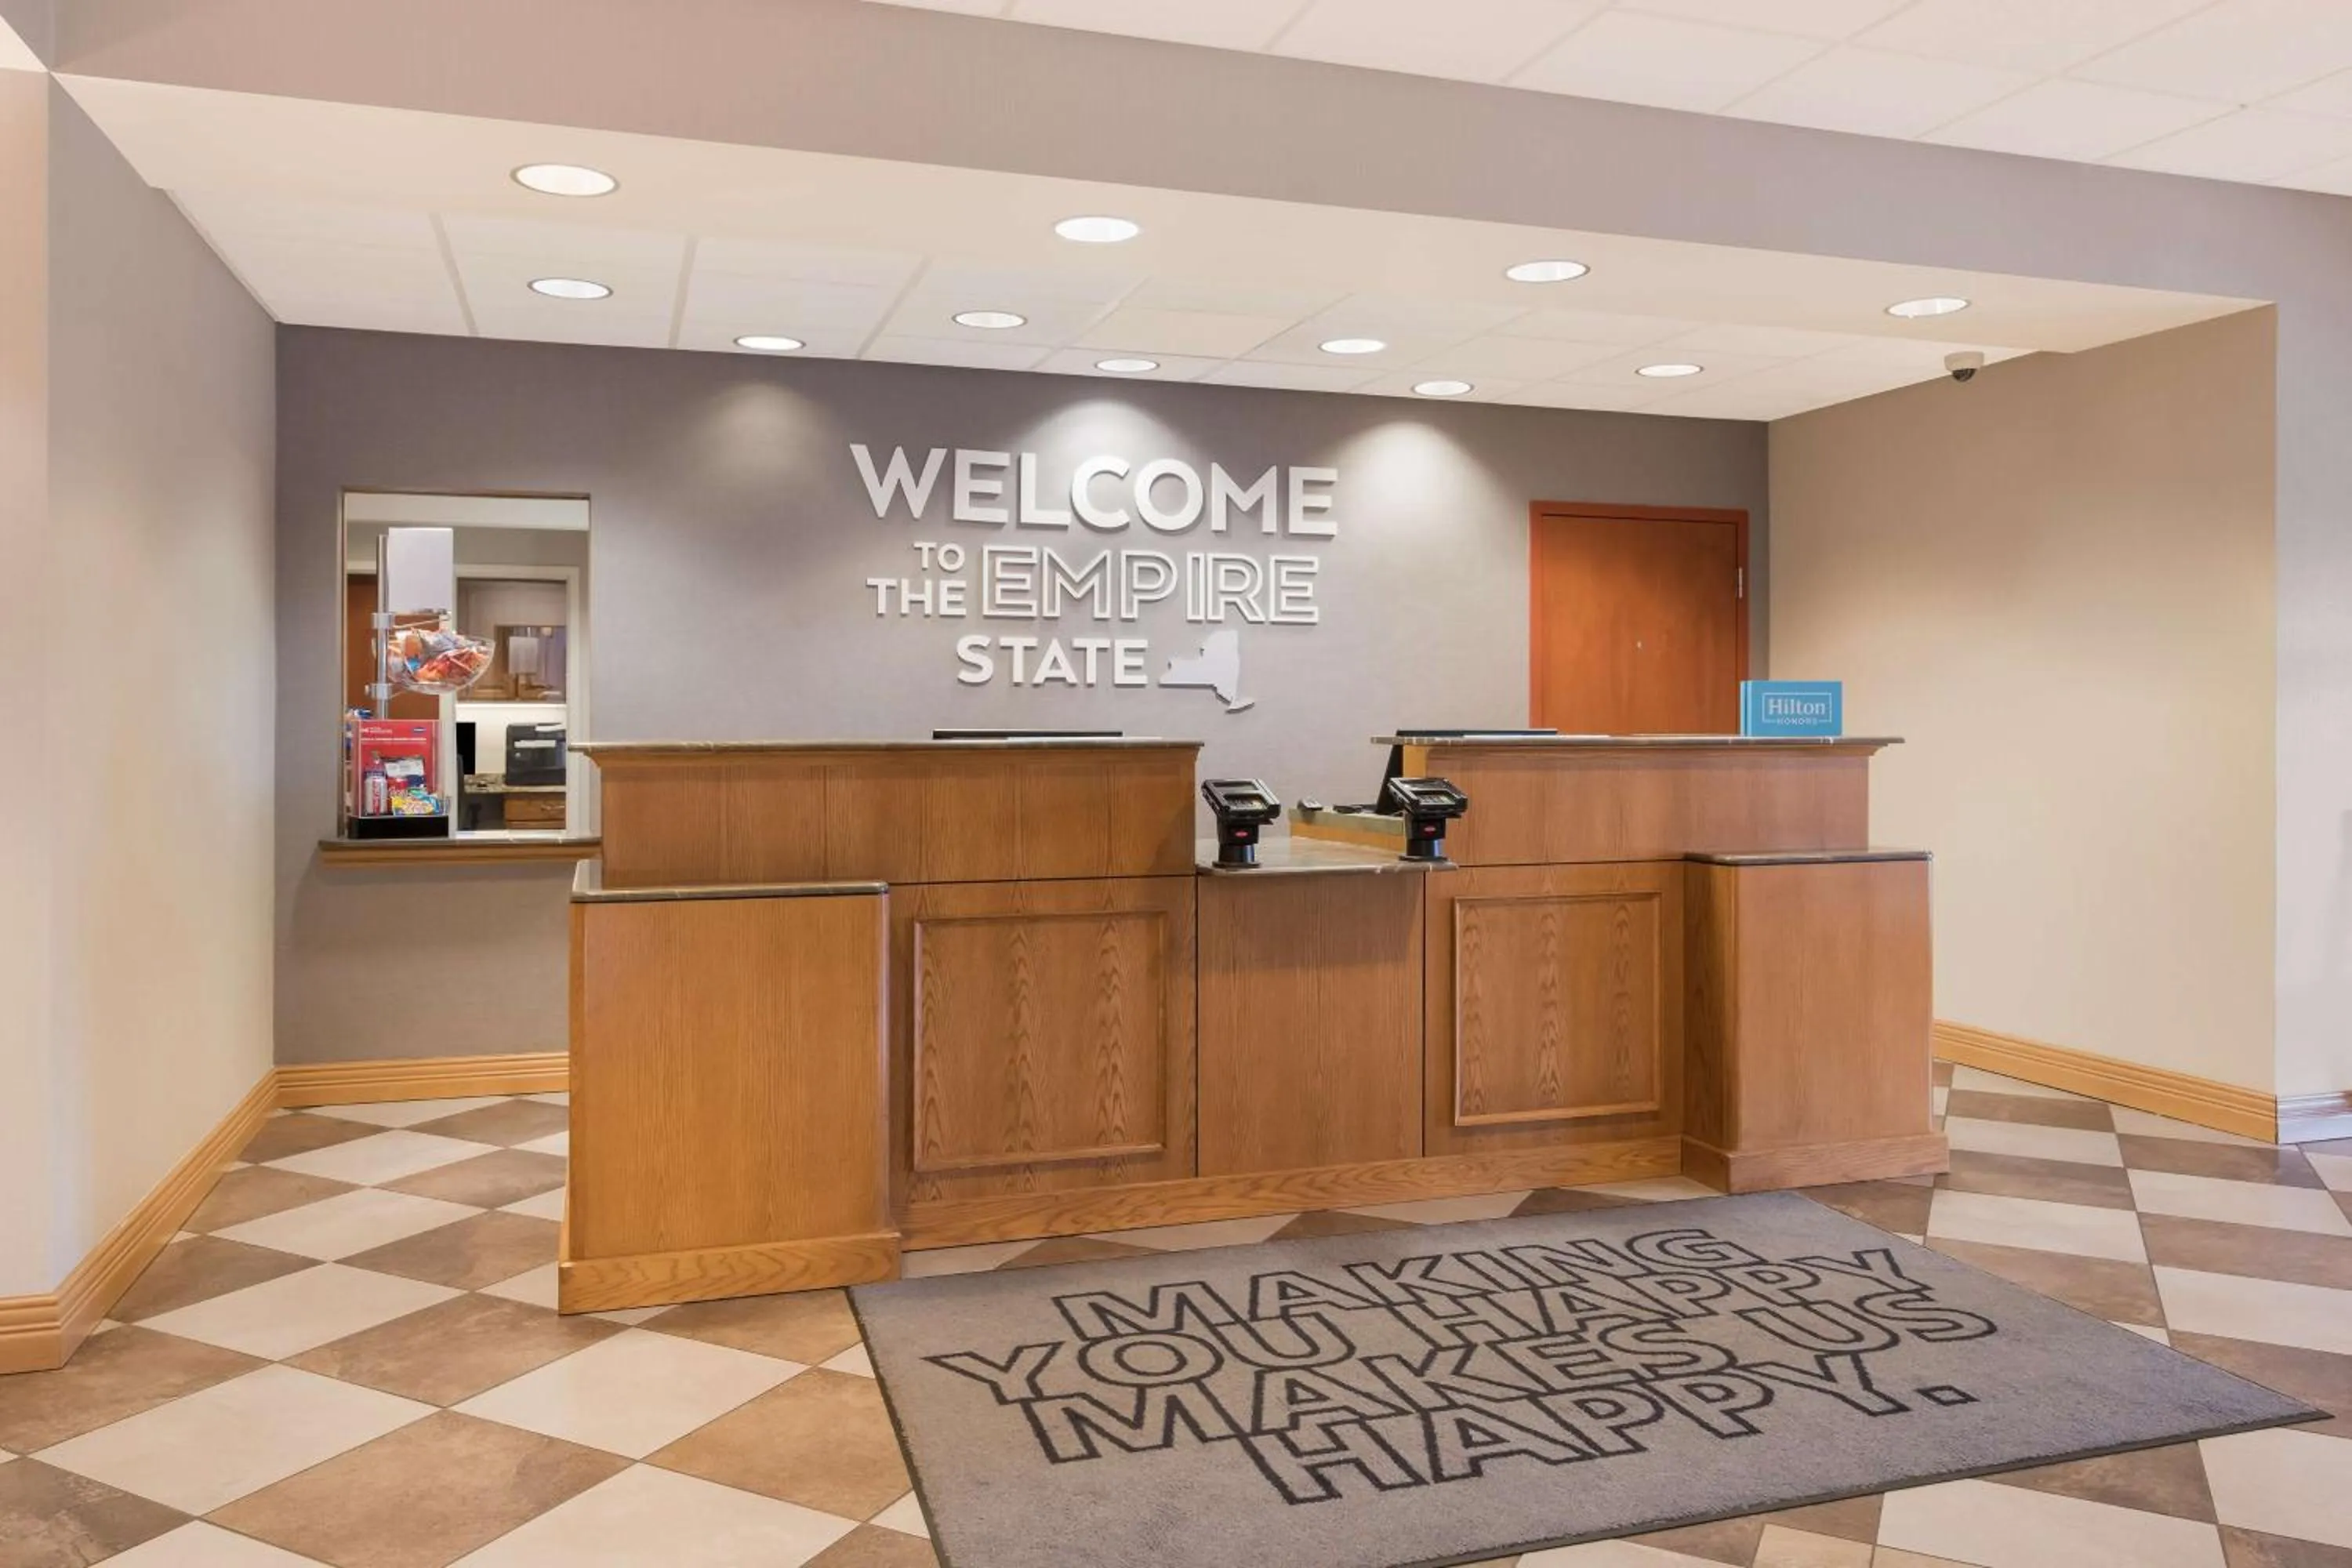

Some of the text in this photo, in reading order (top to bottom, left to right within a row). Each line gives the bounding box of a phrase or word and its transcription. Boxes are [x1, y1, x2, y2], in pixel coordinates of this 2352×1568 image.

[849, 444, 1338, 536] WELCOME
[866, 544, 1319, 624] THE EMPIRE
[913, 541, 965, 572] TO
[956, 635, 1149, 686] STATE
[1767, 698, 1826, 716] Hilton
[920, 1247, 1935, 1406] YOU HAPPY
[1052, 1229, 1770, 1341] MAKING
[1021, 1290, 1998, 1465] MAKES US
[1242, 1352, 1980, 1505] HAPPY.
